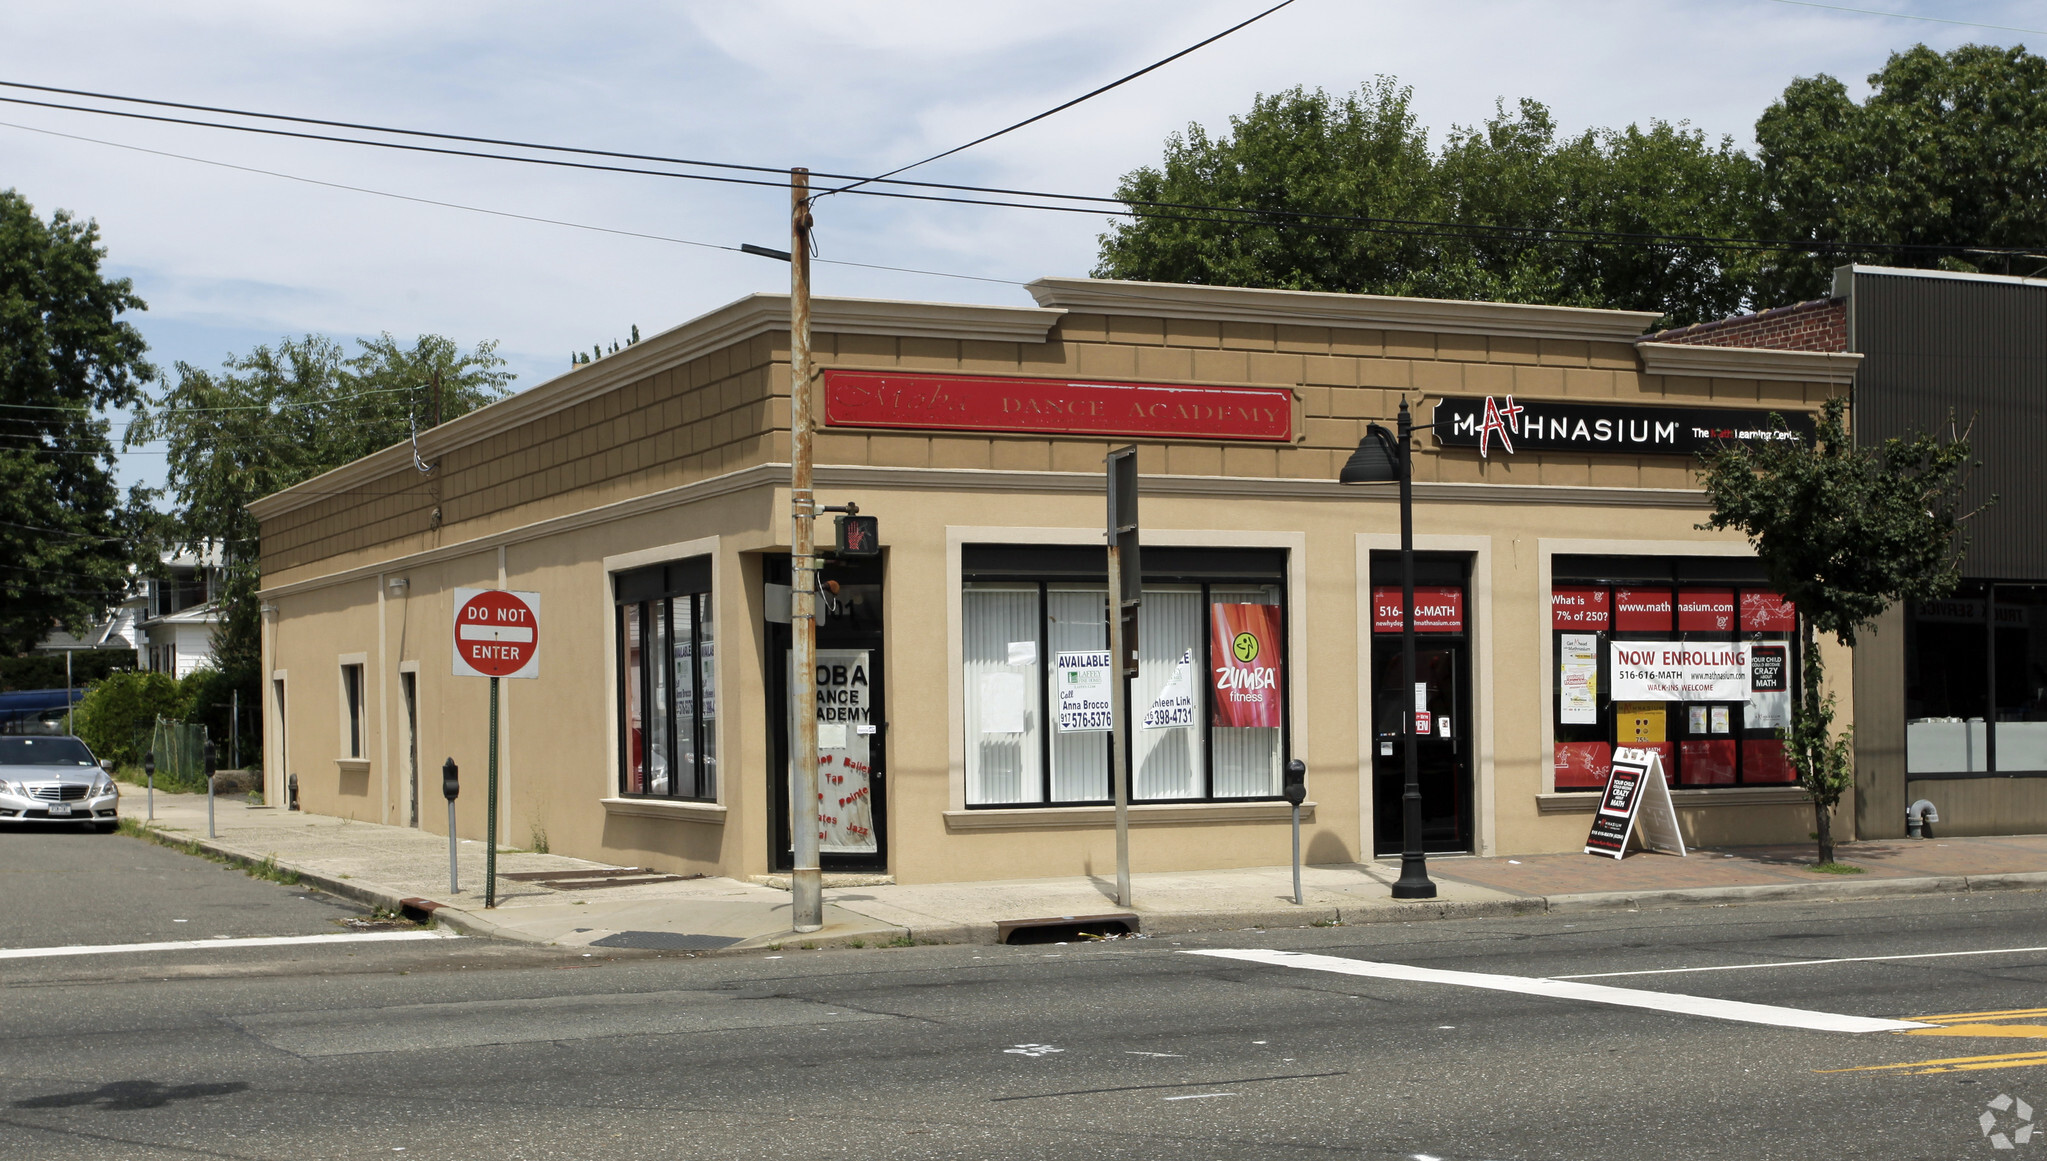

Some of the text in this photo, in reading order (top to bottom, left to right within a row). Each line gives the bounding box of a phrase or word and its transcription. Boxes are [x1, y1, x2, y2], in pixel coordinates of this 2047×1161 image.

[1002, 398, 1105, 417] DANCE
[1128, 402, 1279, 423] ACADEMY
[1453, 394, 1675, 458] MATHNASIUM
[1692, 427, 1709, 438] The
[1551, 595, 1585, 605] What is
[468, 606, 526, 622] DO NOT
[1379, 606, 1455, 617] 516-6-MATH
[1556, 611, 1608, 622] 7% of 250?
[473, 645, 520, 660] ENTER
[1618, 651, 1746, 666] NOW ENROLLING
[1059, 654, 1110, 668] AVAILABLE
[816, 665, 868, 686] OBA
[1619, 671, 1746, 680] 516-616-MATH www.mathnasium.com
[1754, 667, 1779, 675] CRAZY
[1215, 666, 1276, 691] ZUMBA
[1756, 679, 1777, 687] MATH
[1681, 684, 1714, 692] WELCOME
[816, 690, 860, 705] ANCE
[1060, 690, 1074, 700] Call
[1229, 691, 1263, 702] fitness
[1062, 700, 1109, 711] Anna Brocco
[1152, 696, 1191, 708] hleen Link
[816, 707, 870, 721] ADEMY
[1060, 711, 1112, 728] 917 576-5376
[1154, 708, 1193, 725] 398-4731
[843, 757, 872, 774] Ballet
[825, 773, 844, 785] Tap
[1613, 789, 1630, 797] CRAZY
[1610, 799, 1626, 808] MATH
[818, 814, 838, 825] ates
[846, 822, 869, 836] Jazz
